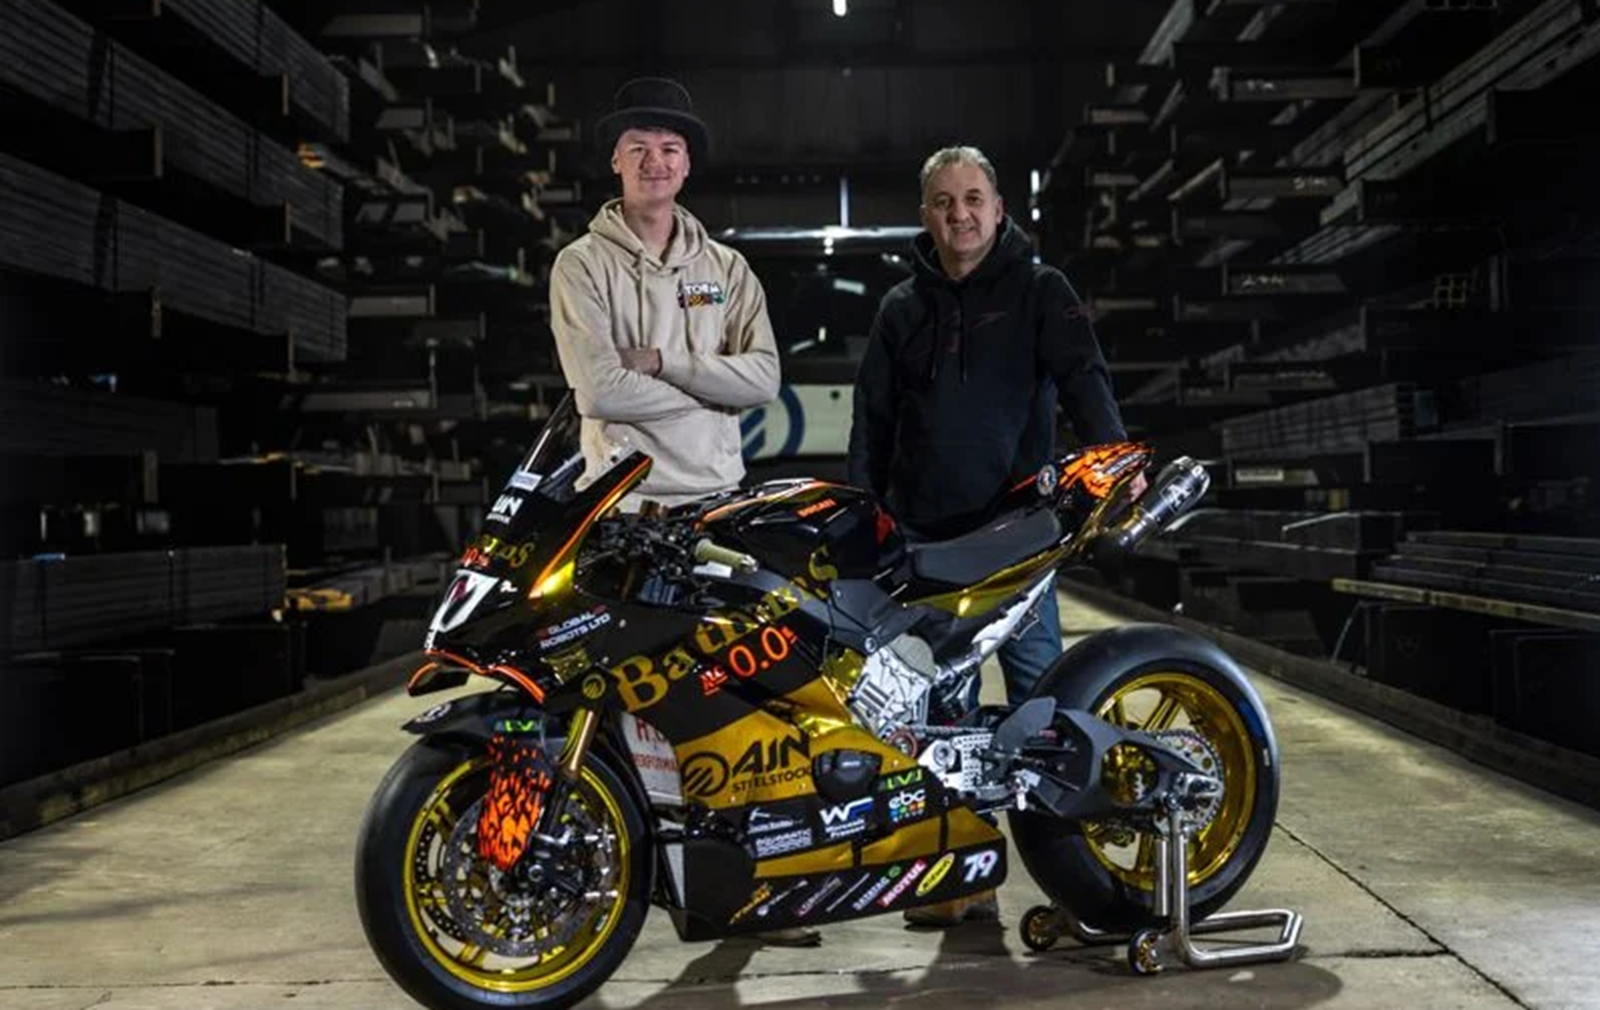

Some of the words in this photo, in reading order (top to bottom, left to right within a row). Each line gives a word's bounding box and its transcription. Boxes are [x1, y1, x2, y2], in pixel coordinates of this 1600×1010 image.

[540, 625, 588, 649] ROBOTS
[588, 613, 611, 630] LTD
[548, 611, 596, 634] GLOBAL
[732, 733, 810, 778] AJN
[881, 862, 927, 905] MOTUL
[964, 850, 999, 883] 79
